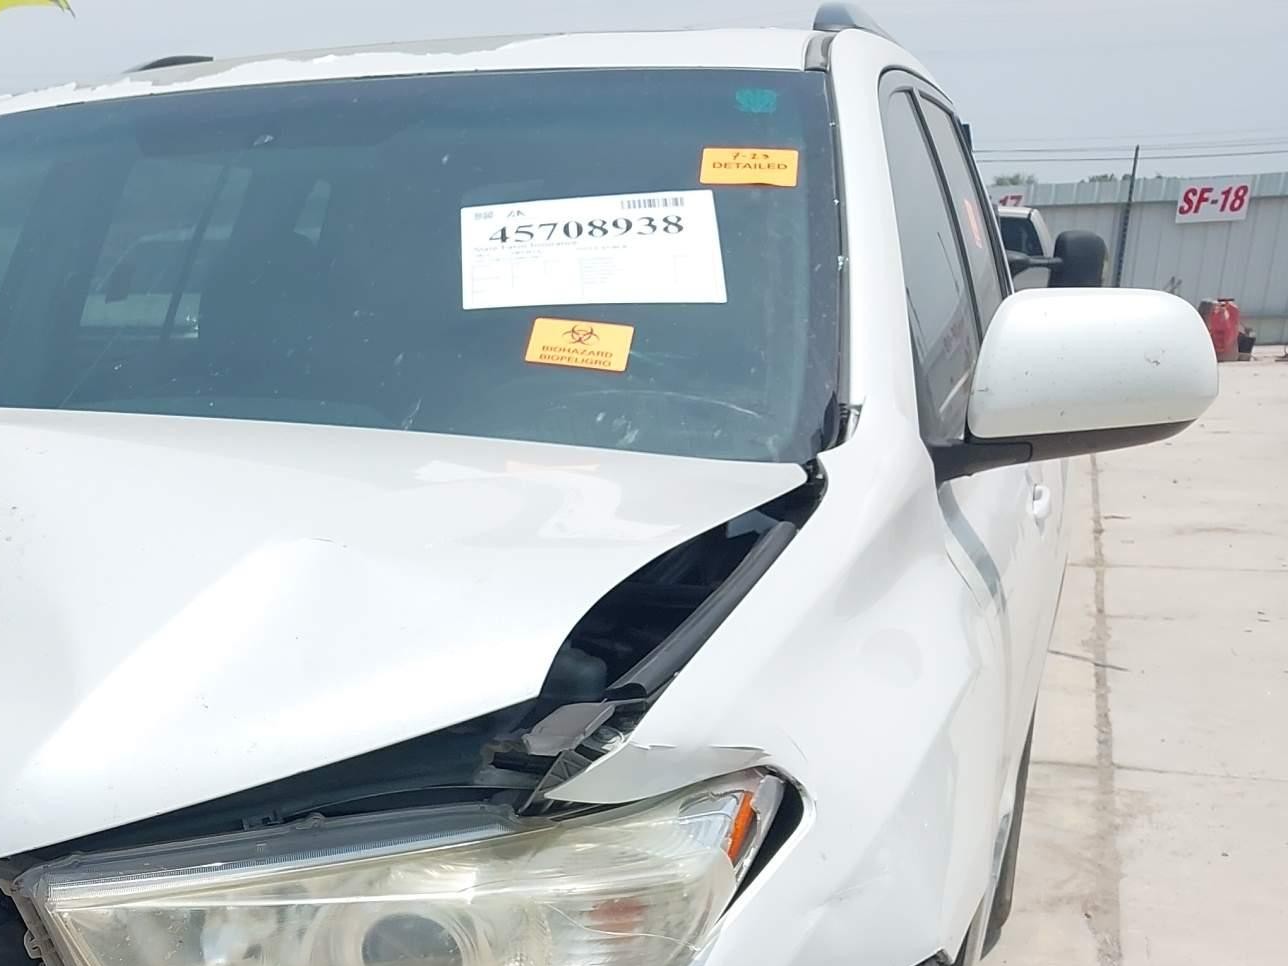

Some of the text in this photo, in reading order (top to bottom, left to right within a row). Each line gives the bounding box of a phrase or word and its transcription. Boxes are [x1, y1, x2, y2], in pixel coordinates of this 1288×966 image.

[713, 162, 788, 170] DETAILED
[1178, 185, 1249, 215] SF-18
[489, 215, 684, 243] 45708938
[541, 345, 613, 358] BIOHAZARD
[539, 353, 612, 367] BIOPELIGRO
